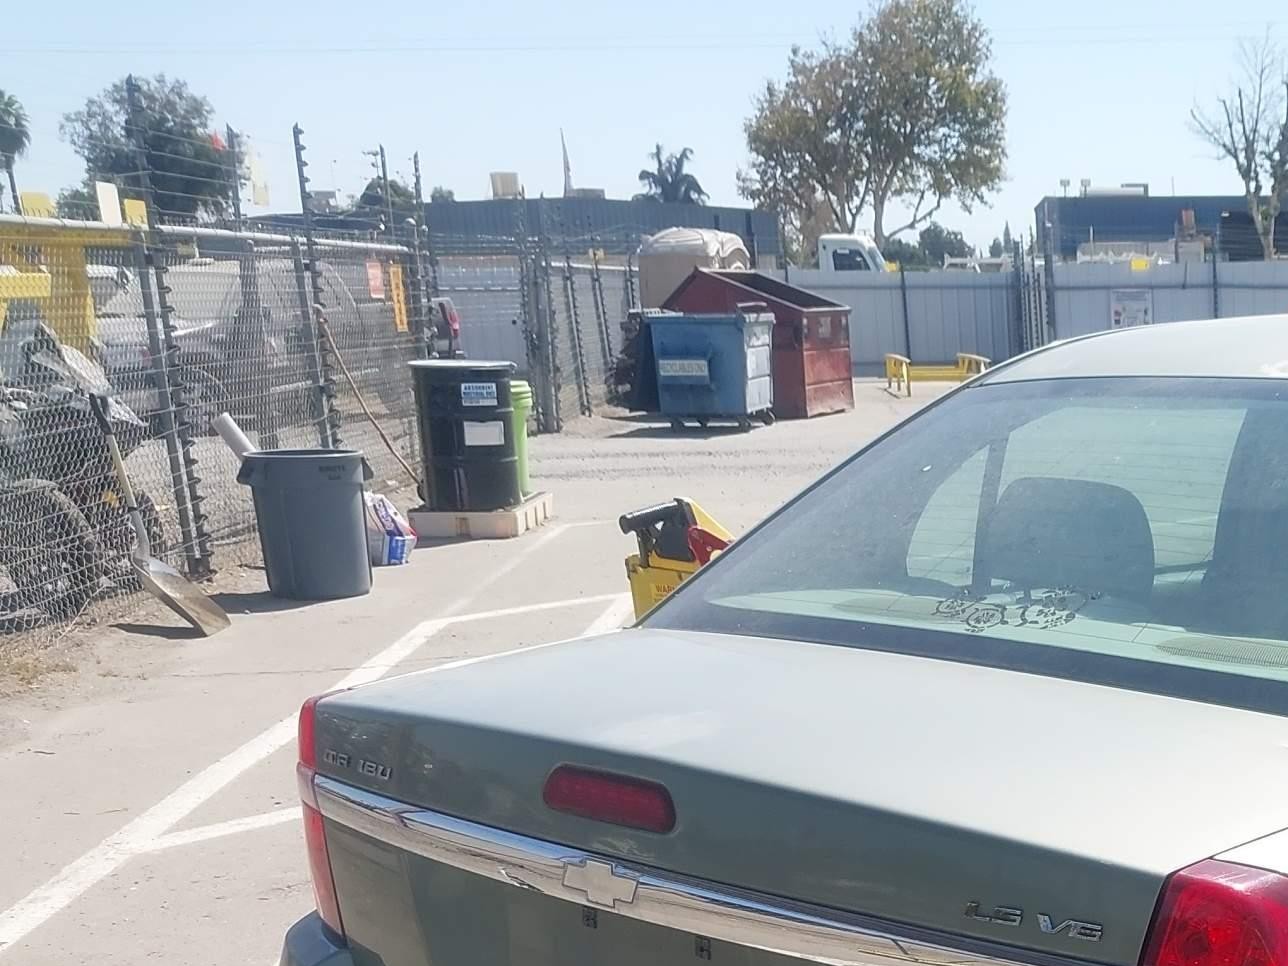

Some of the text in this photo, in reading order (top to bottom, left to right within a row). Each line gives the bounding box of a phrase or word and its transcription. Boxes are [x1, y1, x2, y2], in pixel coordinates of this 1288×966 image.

[655, 585, 676, 593] WAR
[963, 900, 1104, 943] LS V6
